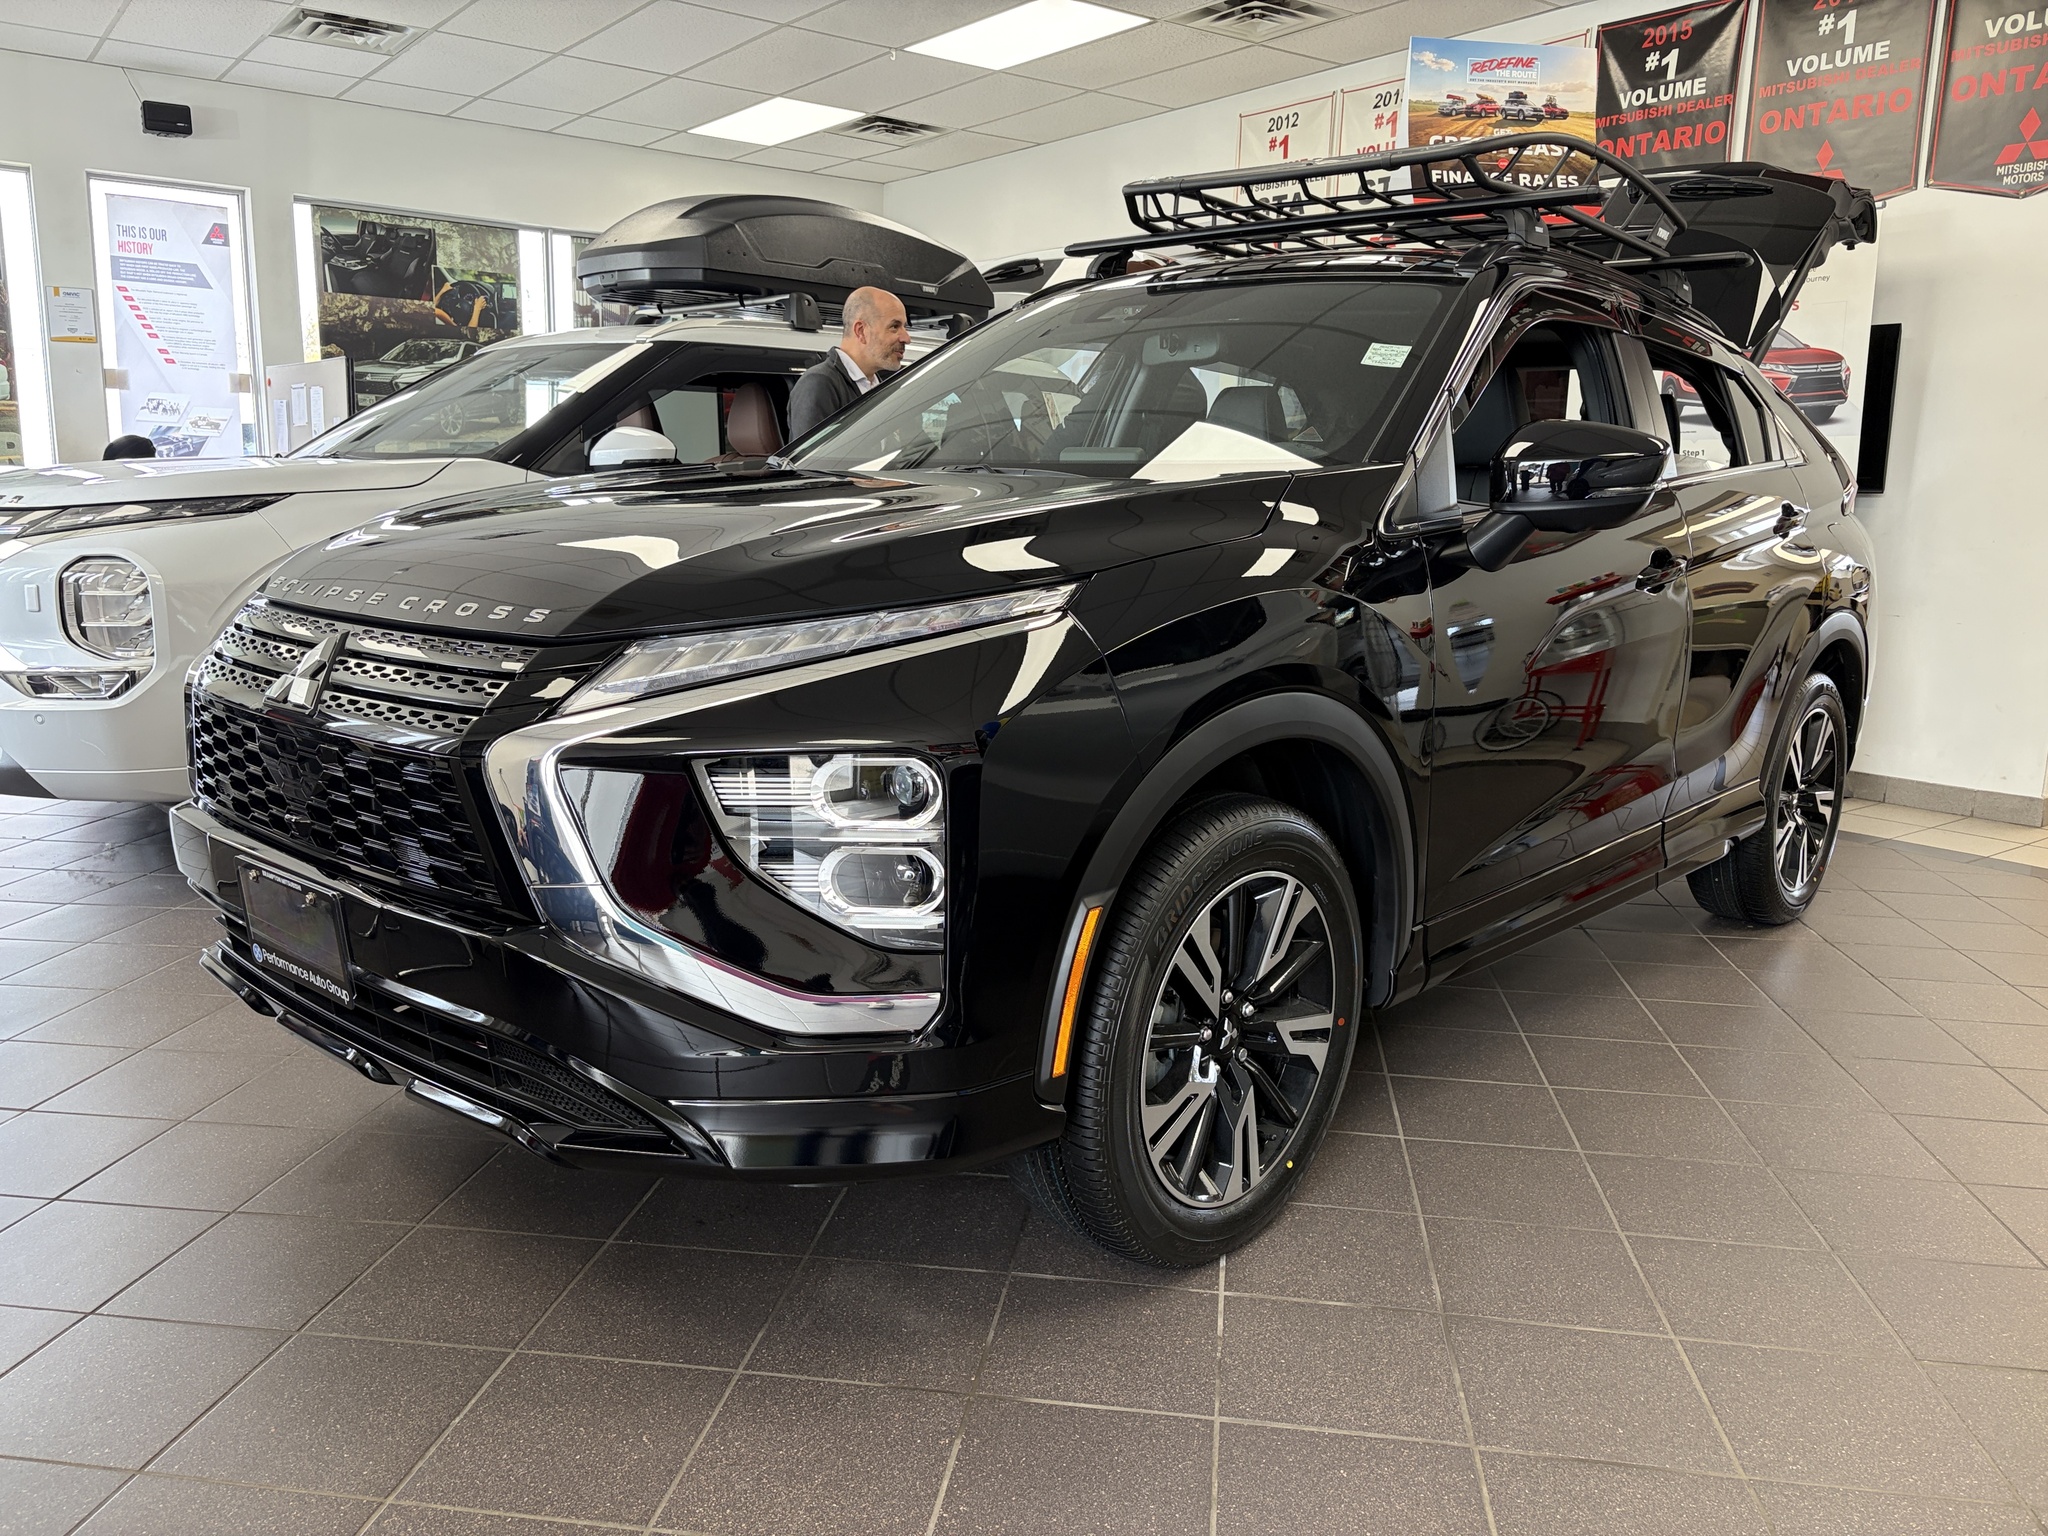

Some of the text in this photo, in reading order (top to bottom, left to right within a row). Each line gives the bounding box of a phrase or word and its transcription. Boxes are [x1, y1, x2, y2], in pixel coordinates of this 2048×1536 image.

[1642, 18, 1693, 49] 2015
[1818, 9, 1857, 45] #1
[1985, 8, 2048, 38] VOL
[1470, 57, 1538, 75] REDEFINE
[1645, 48, 1679, 80] #1
[1786, 40, 1891, 77] VOLUME
[1495, 70, 1537, 79] THE ROUTE
[1759, 57, 1922, 99] MITSUBISHI DEALER
[1373, 88, 1403, 109] 201
[1619, 77, 1707, 109] VOLUME
[1267, 112, 1300, 133] 2012
[1374, 110, 1398, 138] #1
[1595, 93, 1734, 129] MITSUBISHI DEALER
[1759, 87, 1913, 134] ONTARIO
[1268, 134, 1290, 159] #1
[1596, 120, 1726, 159] ONTARIO
[1240, 180, 1290, 195] MSUBISHI
[1431, 169, 1513, 184] FINACE
[1519, 173, 1579, 188] RATES
[2002, 171, 2045, 186] MOTORS
[116, 224, 168, 242] THIS IS OUR
[117, 240, 154, 255] HISTORY
[1805, 275, 1831, 283] ourney
[1682, 449, 1705, 458] Step 1
[269, 575, 552, 624] ECLIPSE CROSS
[1152, 827, 1264, 951] BRIDGESTONE
[262, 948, 350, 1005] Performance Auto Group
